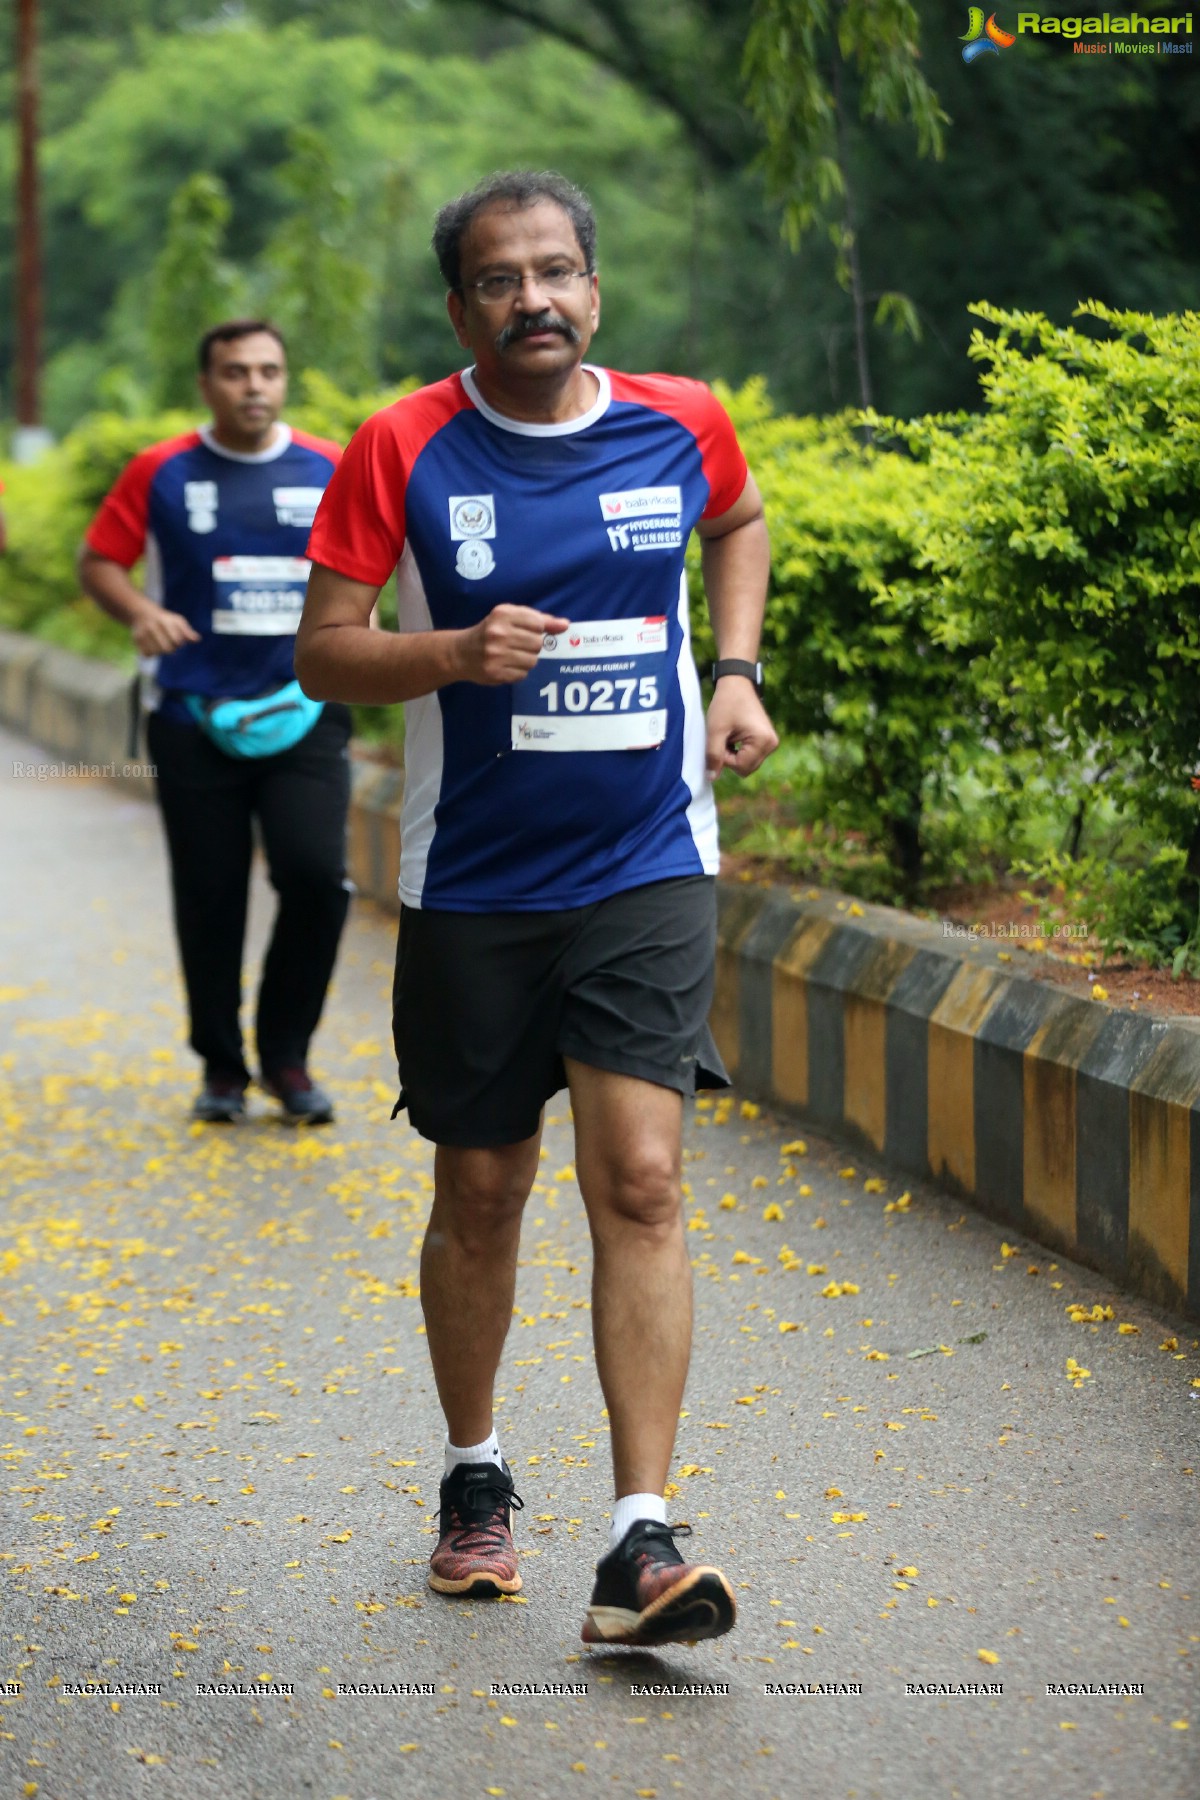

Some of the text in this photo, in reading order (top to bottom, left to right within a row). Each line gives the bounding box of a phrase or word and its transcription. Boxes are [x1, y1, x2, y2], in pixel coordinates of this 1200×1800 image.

[629, 517, 680, 532] HYDERABAD
[631, 531, 681, 545] RUNNERS
[559, 661, 636, 674] RAJENDRA KUMAR P
[539, 676, 659, 713] 10275
